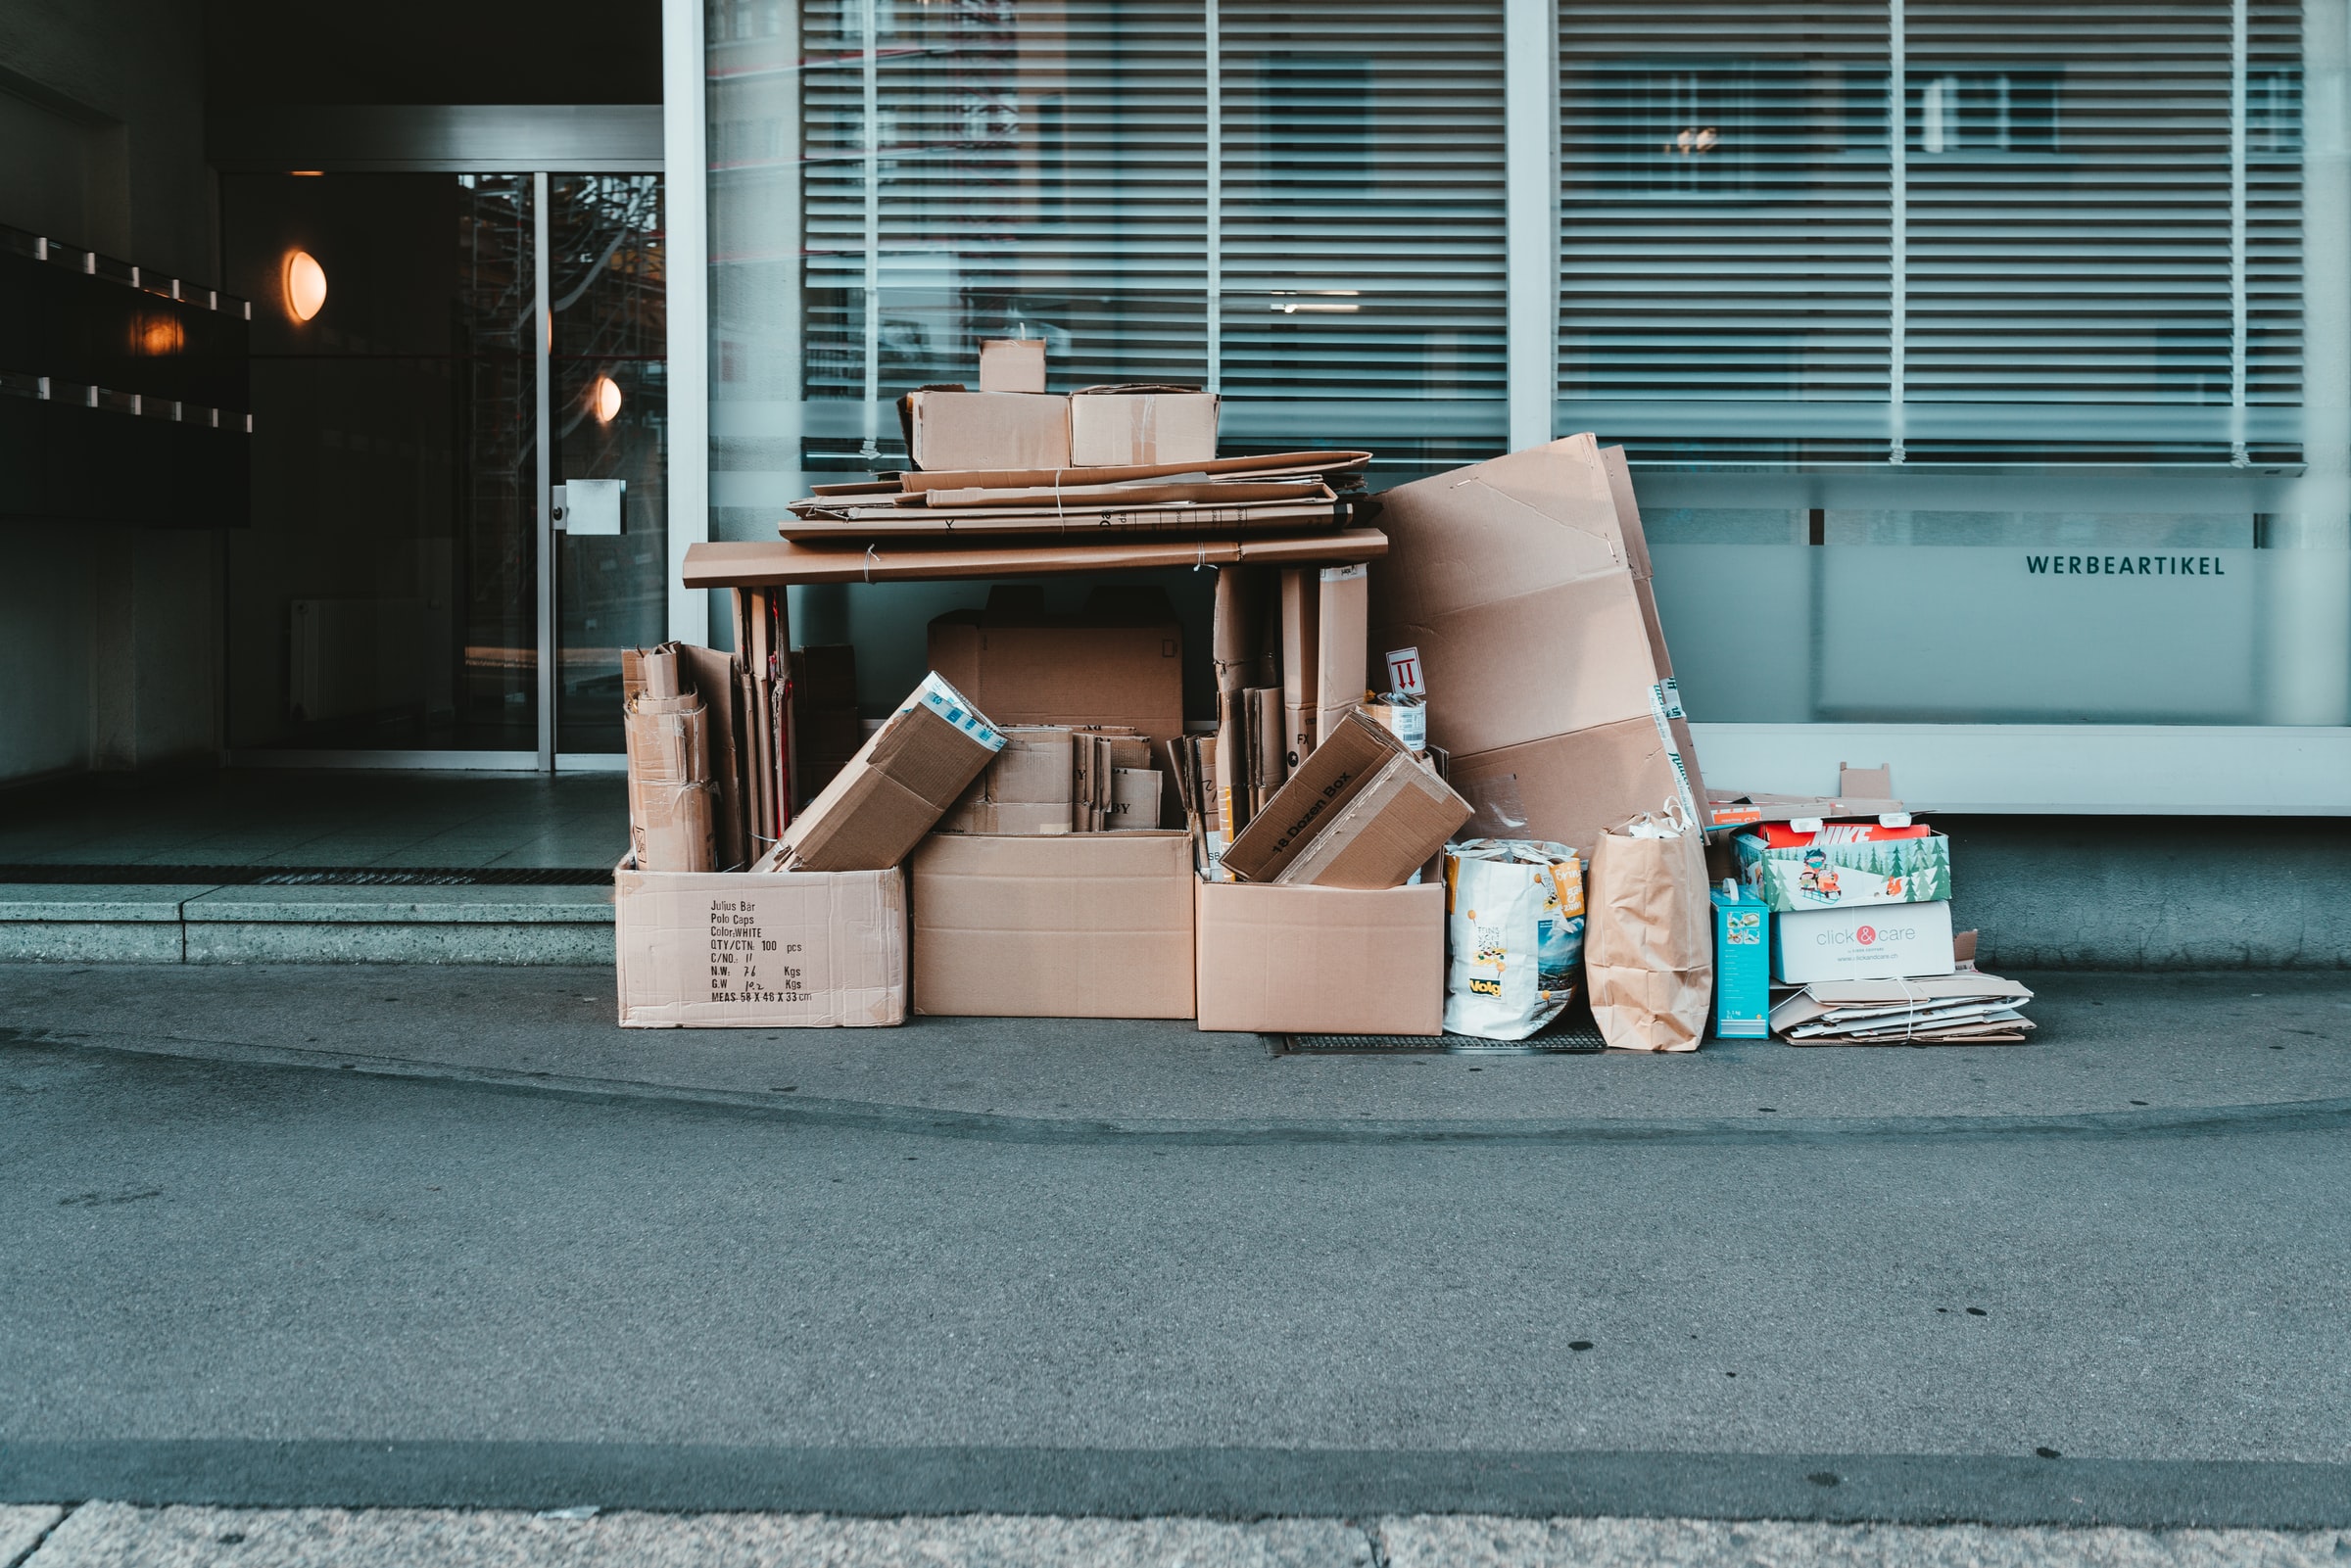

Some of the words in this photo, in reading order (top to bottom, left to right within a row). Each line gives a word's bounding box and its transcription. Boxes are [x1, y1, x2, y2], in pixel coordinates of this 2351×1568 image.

[2026, 555, 2225, 575] WERBEARTIKEL
[1272, 838, 1290, 853] 18
[1286, 799, 1326, 838] Dozen
[1322, 772, 1352, 798] Box
[1810, 826, 1873, 846] NIKE
[710, 900, 737, 911] Julius
[710, 913, 730, 924] Polo
[733, 915, 754, 927] Caps
[1816, 928, 1855, 946] click
[1878, 927, 1916, 942] care
[761, 940, 777, 951] 100
[787, 944, 802, 954] pcs
[784, 966, 801, 978] Kgs
[786, 979, 801, 990] Kgs
[1469, 979, 1502, 997] Volg
[786, 992, 797, 1002] 33
